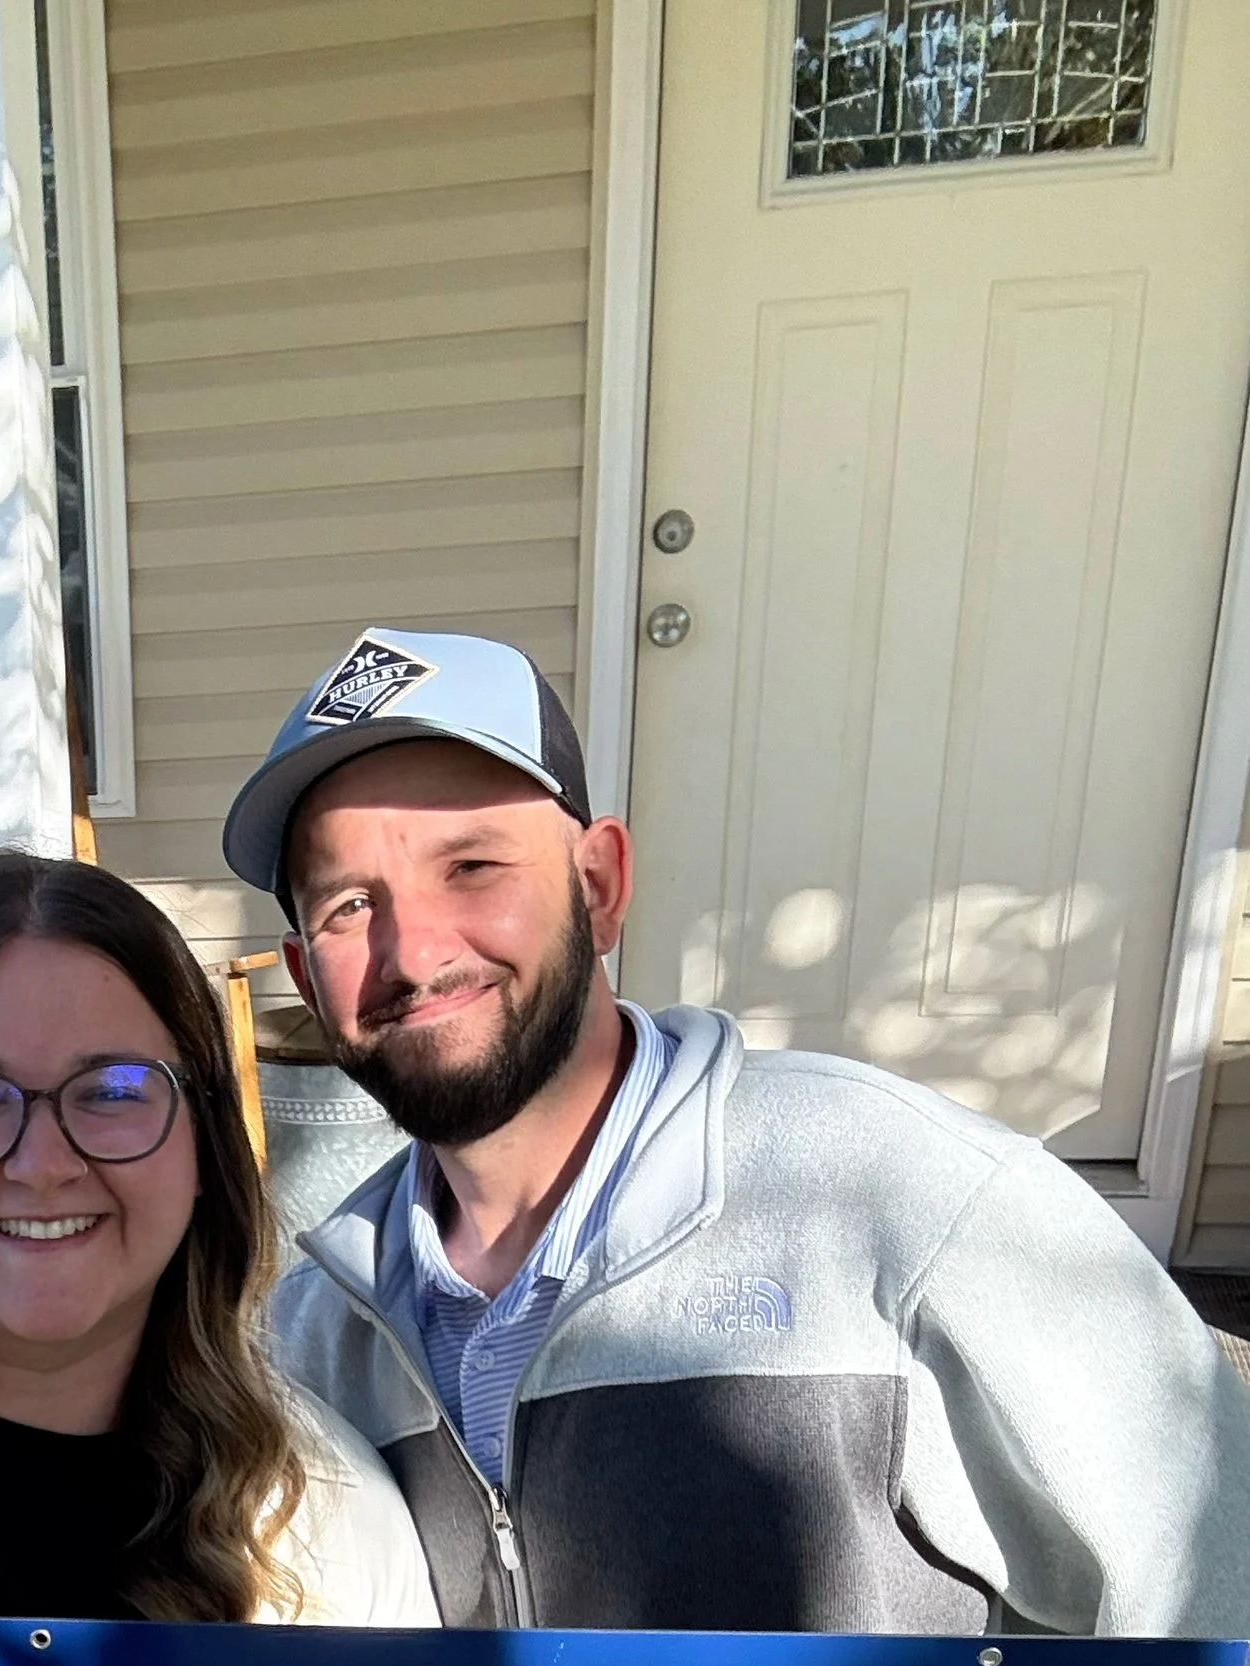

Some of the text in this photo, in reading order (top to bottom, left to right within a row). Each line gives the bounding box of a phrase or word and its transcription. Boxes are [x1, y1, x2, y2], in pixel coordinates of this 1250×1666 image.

[328, 665, 408, 703] HURLEY
[710, 1275, 753, 1296] THE
[676, 1296, 752, 1318] NORTH
[697, 1315, 751, 1335] FACE
